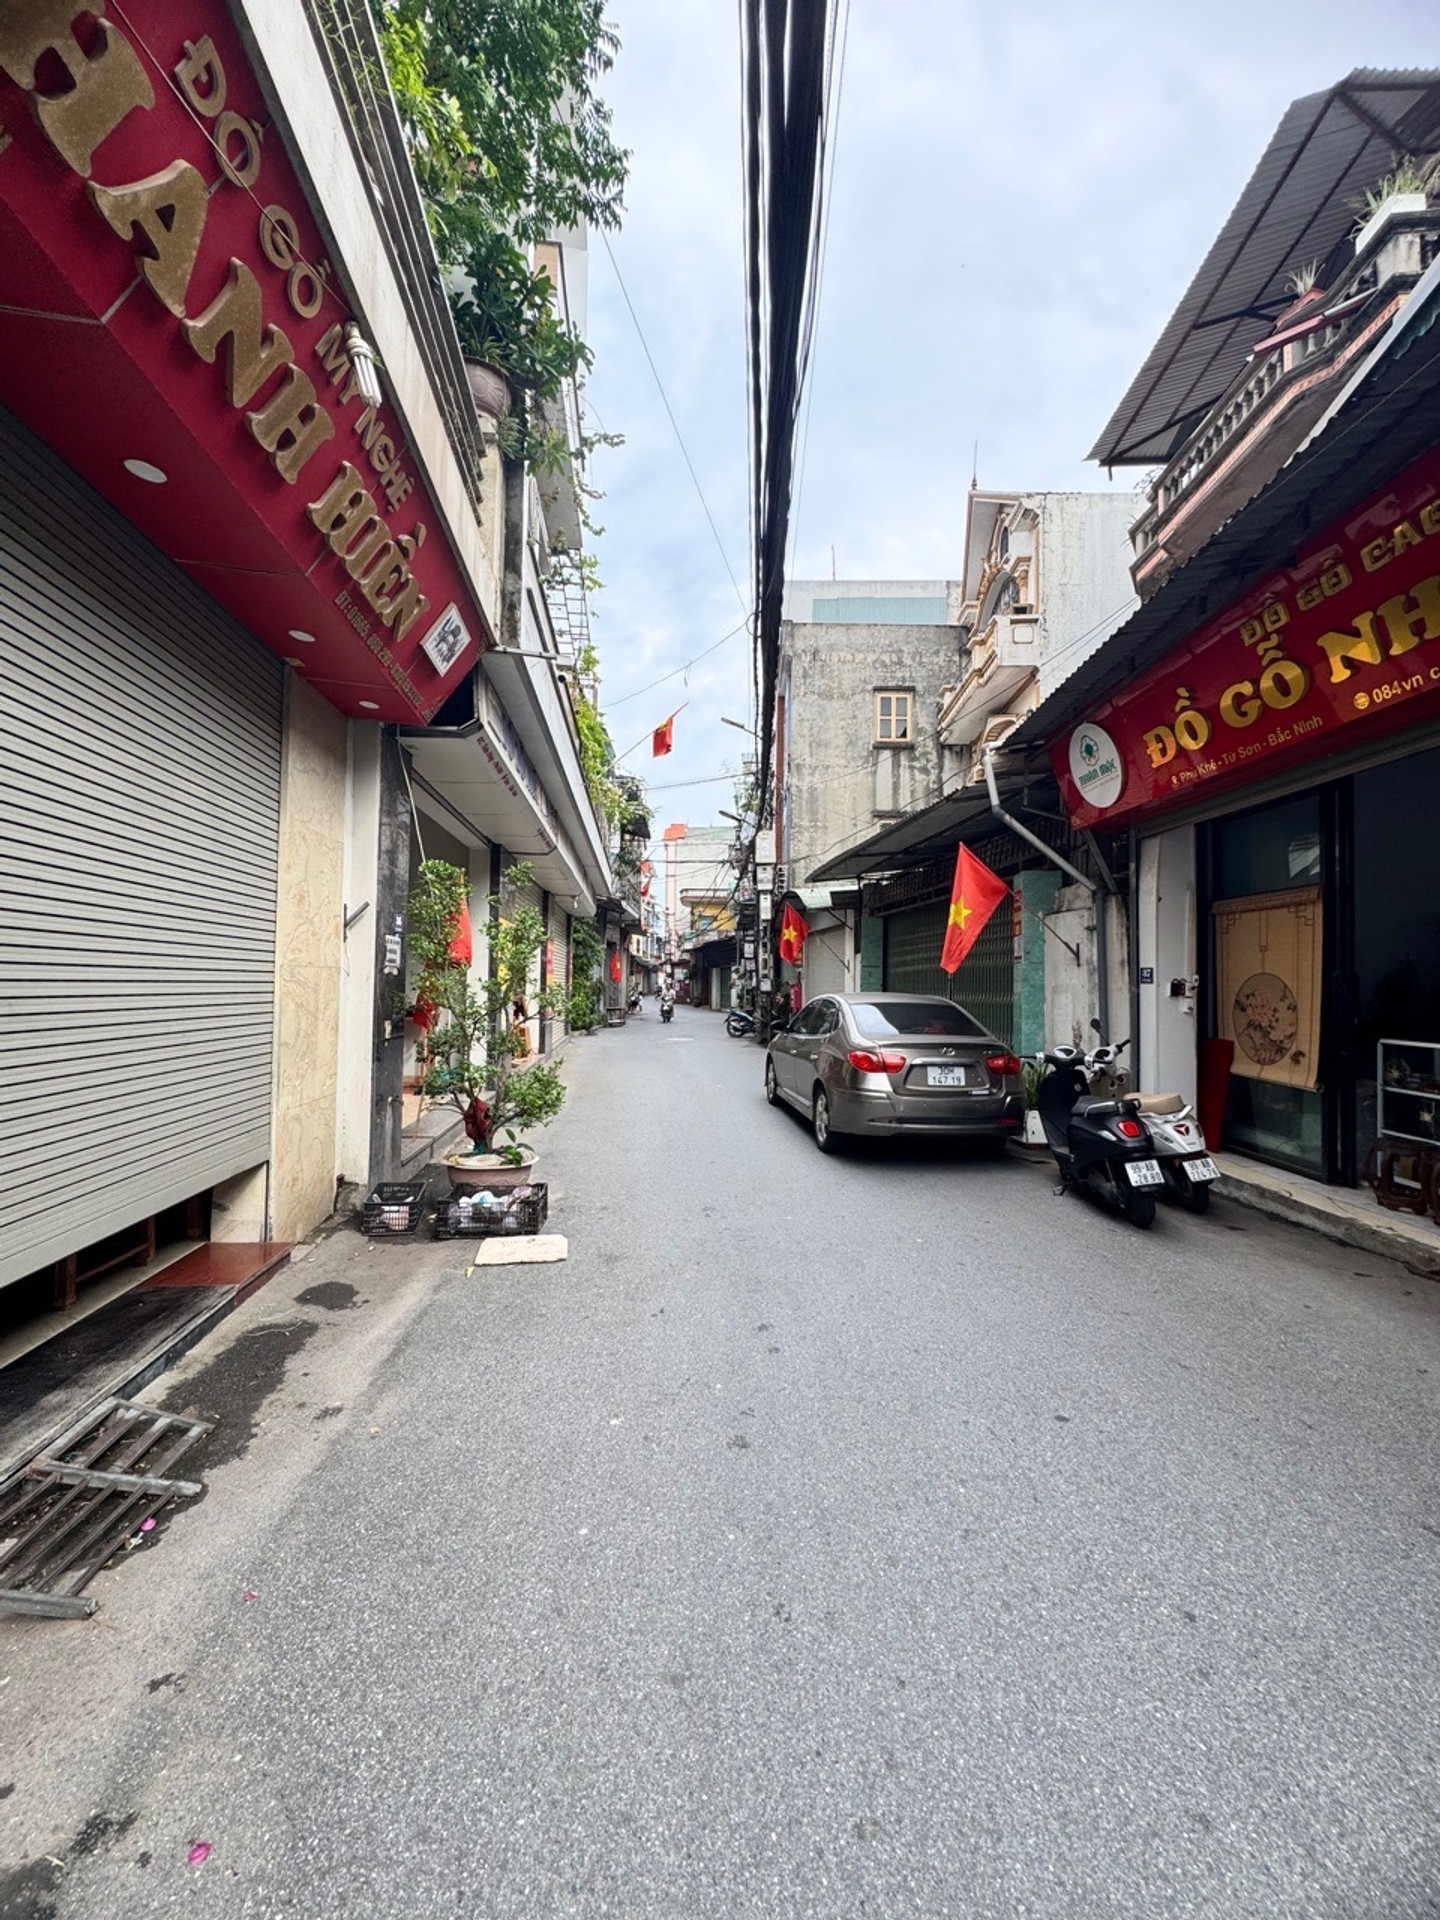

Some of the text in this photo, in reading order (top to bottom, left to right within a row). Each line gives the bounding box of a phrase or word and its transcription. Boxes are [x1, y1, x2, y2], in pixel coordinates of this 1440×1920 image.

[306, 459, 431, 643] HIỀN
[1142, 687, 1210, 768] ĐỒ
[1219, 633, 1306, 728] GỖ
[1237, 742, 1262, 759] Sơn
[1268, 727, 1292, 747] Bắc
